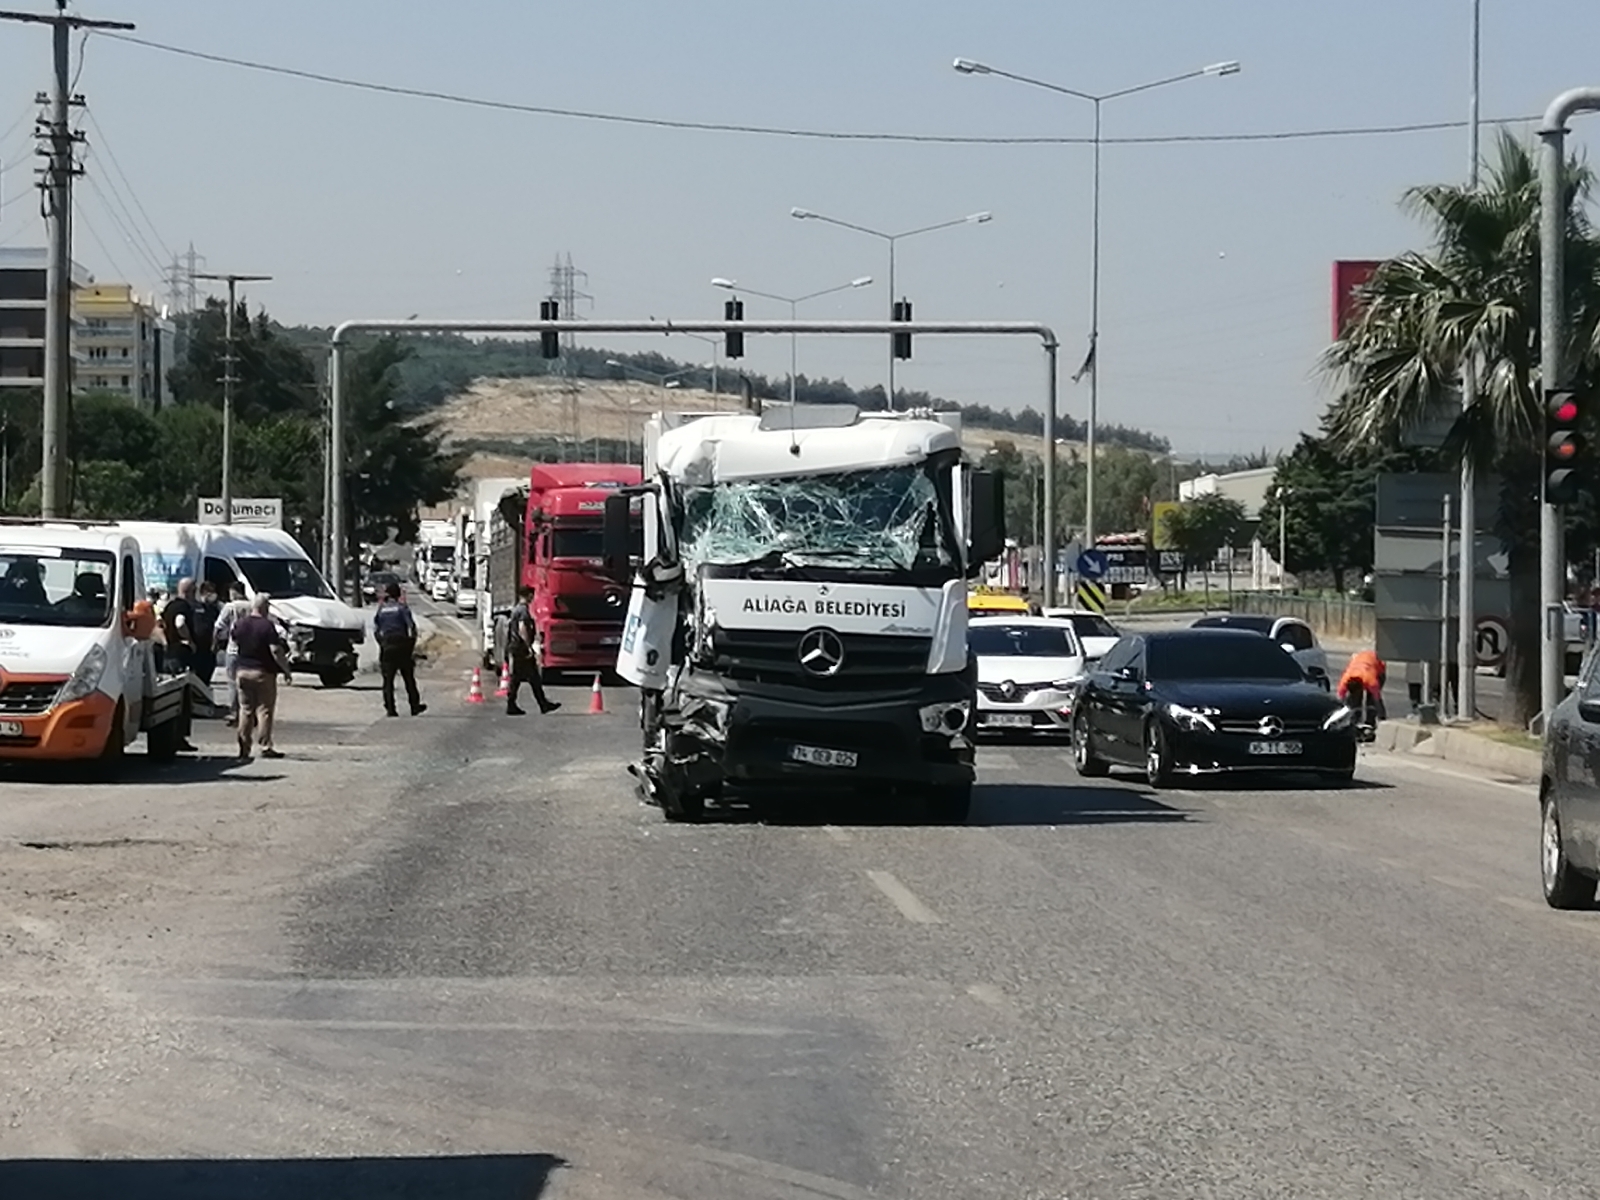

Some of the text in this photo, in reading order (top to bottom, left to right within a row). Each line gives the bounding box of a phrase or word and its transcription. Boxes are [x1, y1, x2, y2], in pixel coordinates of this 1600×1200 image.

[204, 502, 276, 516] Doumacı
[742, 594, 906, 618] ALİAĞA BELEDİYESİ
